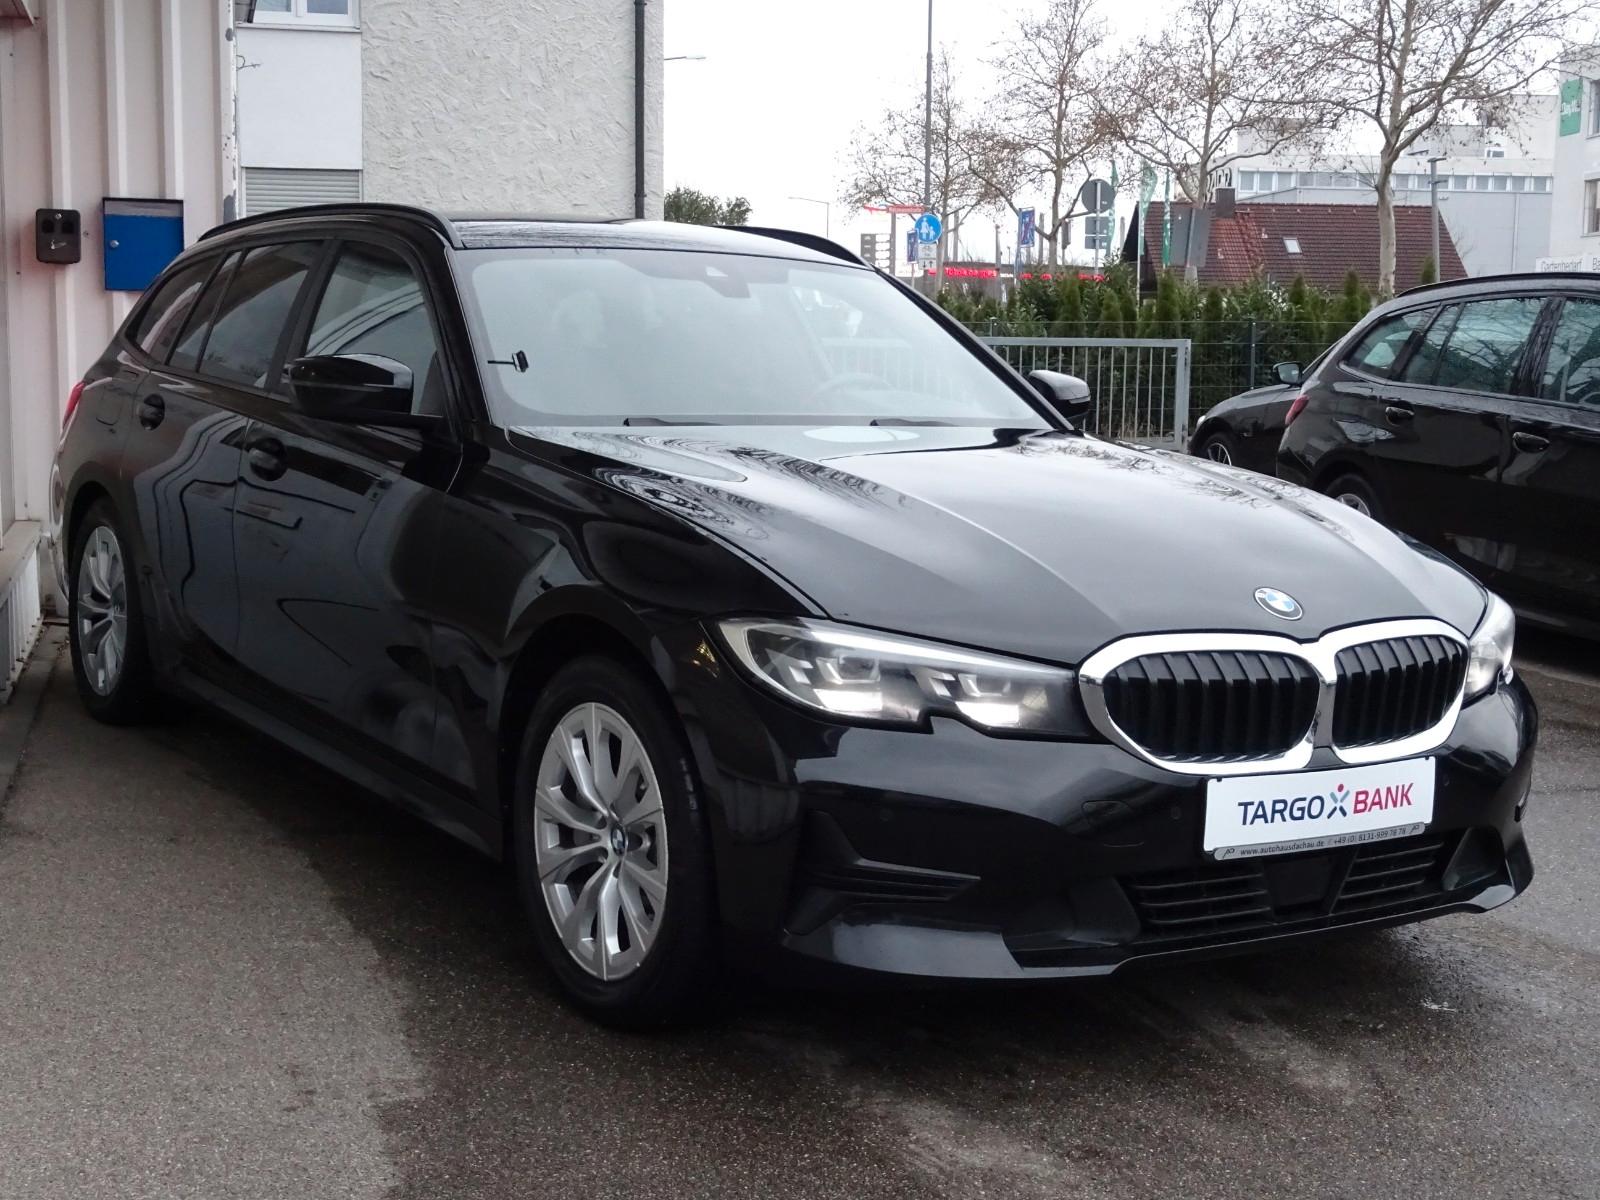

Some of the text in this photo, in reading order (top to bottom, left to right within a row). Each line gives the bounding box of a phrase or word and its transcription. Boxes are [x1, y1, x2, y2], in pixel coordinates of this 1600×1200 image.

[1237, 782, 1414, 826] TARGO BANK
[1240, 839, 1324, 857] www.autohausdachau.de
